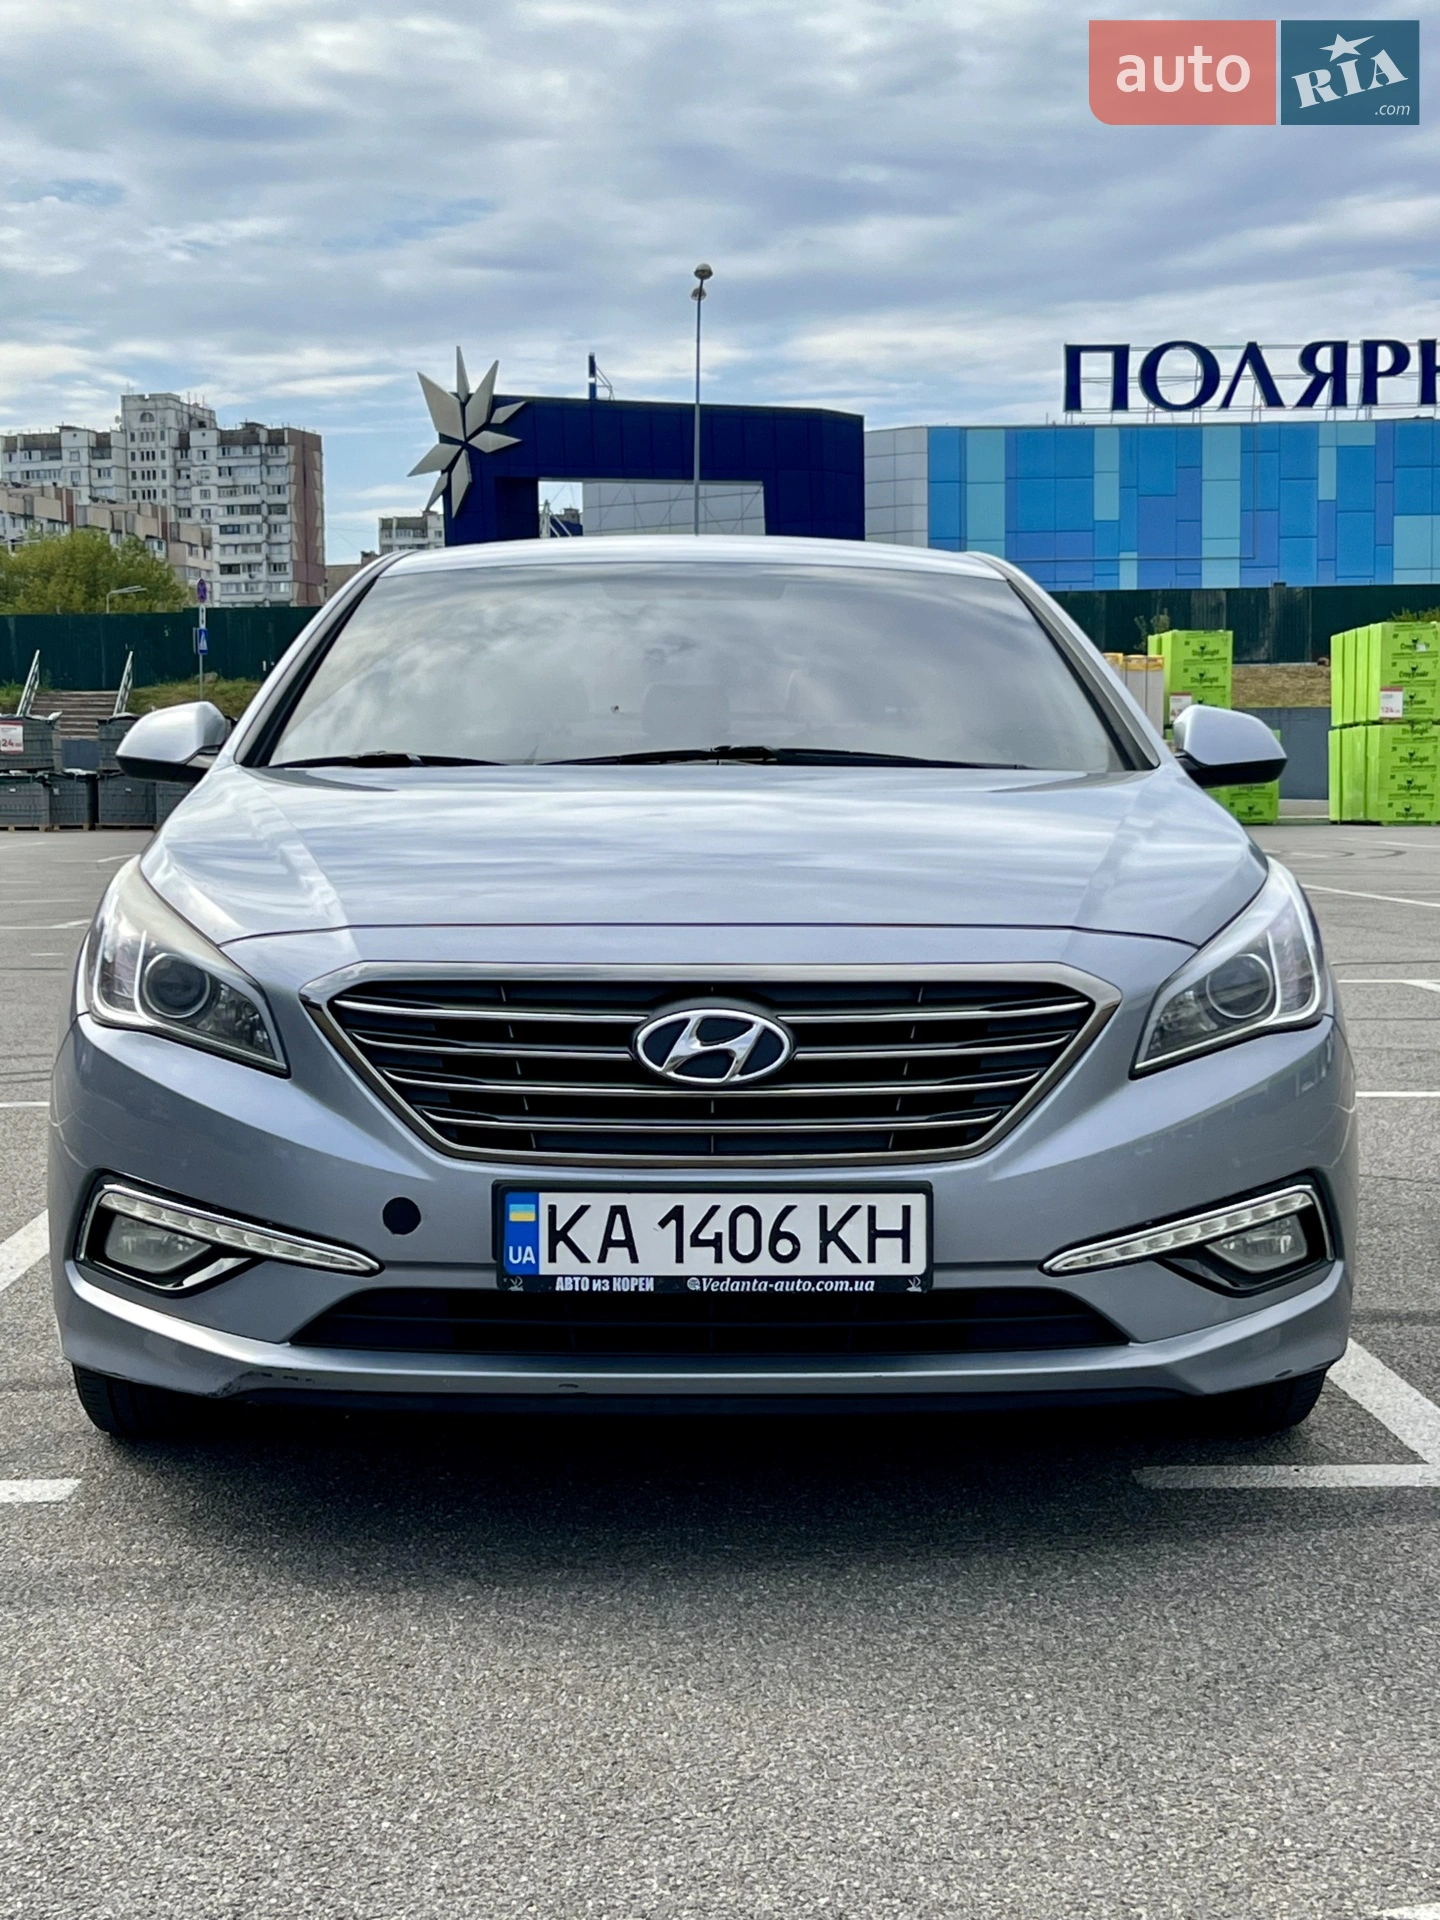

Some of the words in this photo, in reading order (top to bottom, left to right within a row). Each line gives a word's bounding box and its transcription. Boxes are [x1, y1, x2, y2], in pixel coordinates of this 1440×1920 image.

[547, 1204, 639, 1264] KA
[657, 1204, 800, 1264] 1406
[818, 1204, 911, 1264] KH
[508, 1245, 536, 1265] UA
[555, 1276, 590, 1292] АВТО
[592, 1278, 610, 1292] из
[701, 1277, 875, 1293] Vedanta-auto.com.ua
